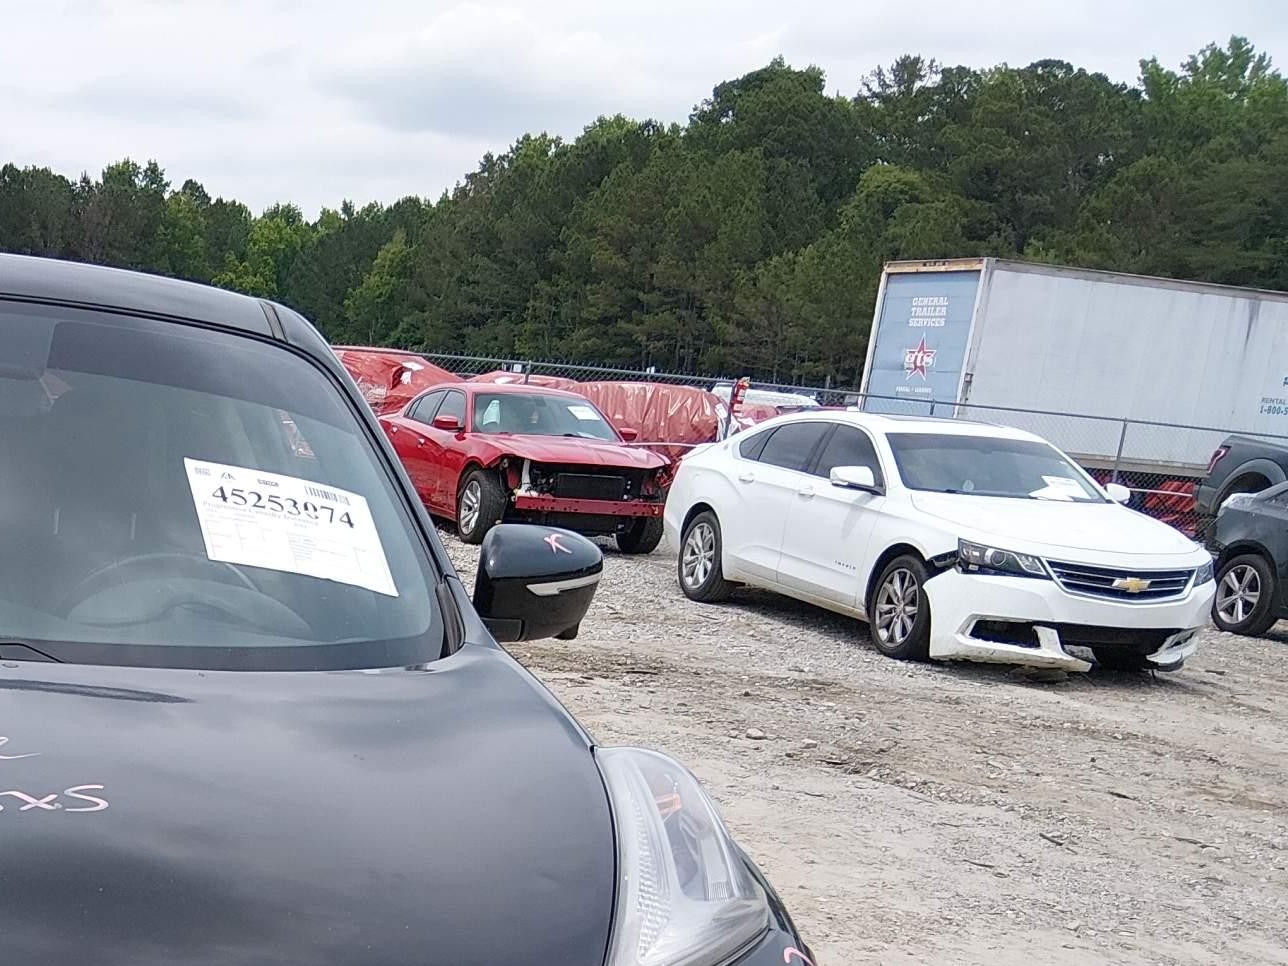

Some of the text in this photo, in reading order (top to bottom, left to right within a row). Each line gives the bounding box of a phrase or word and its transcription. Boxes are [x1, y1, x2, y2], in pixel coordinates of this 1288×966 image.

[912, 296, 949, 306] GENERAL
[911, 306, 947, 316] TRAILER
[908, 317, 946, 327] SERVICES
[211, 484, 355, 529] 45253074
